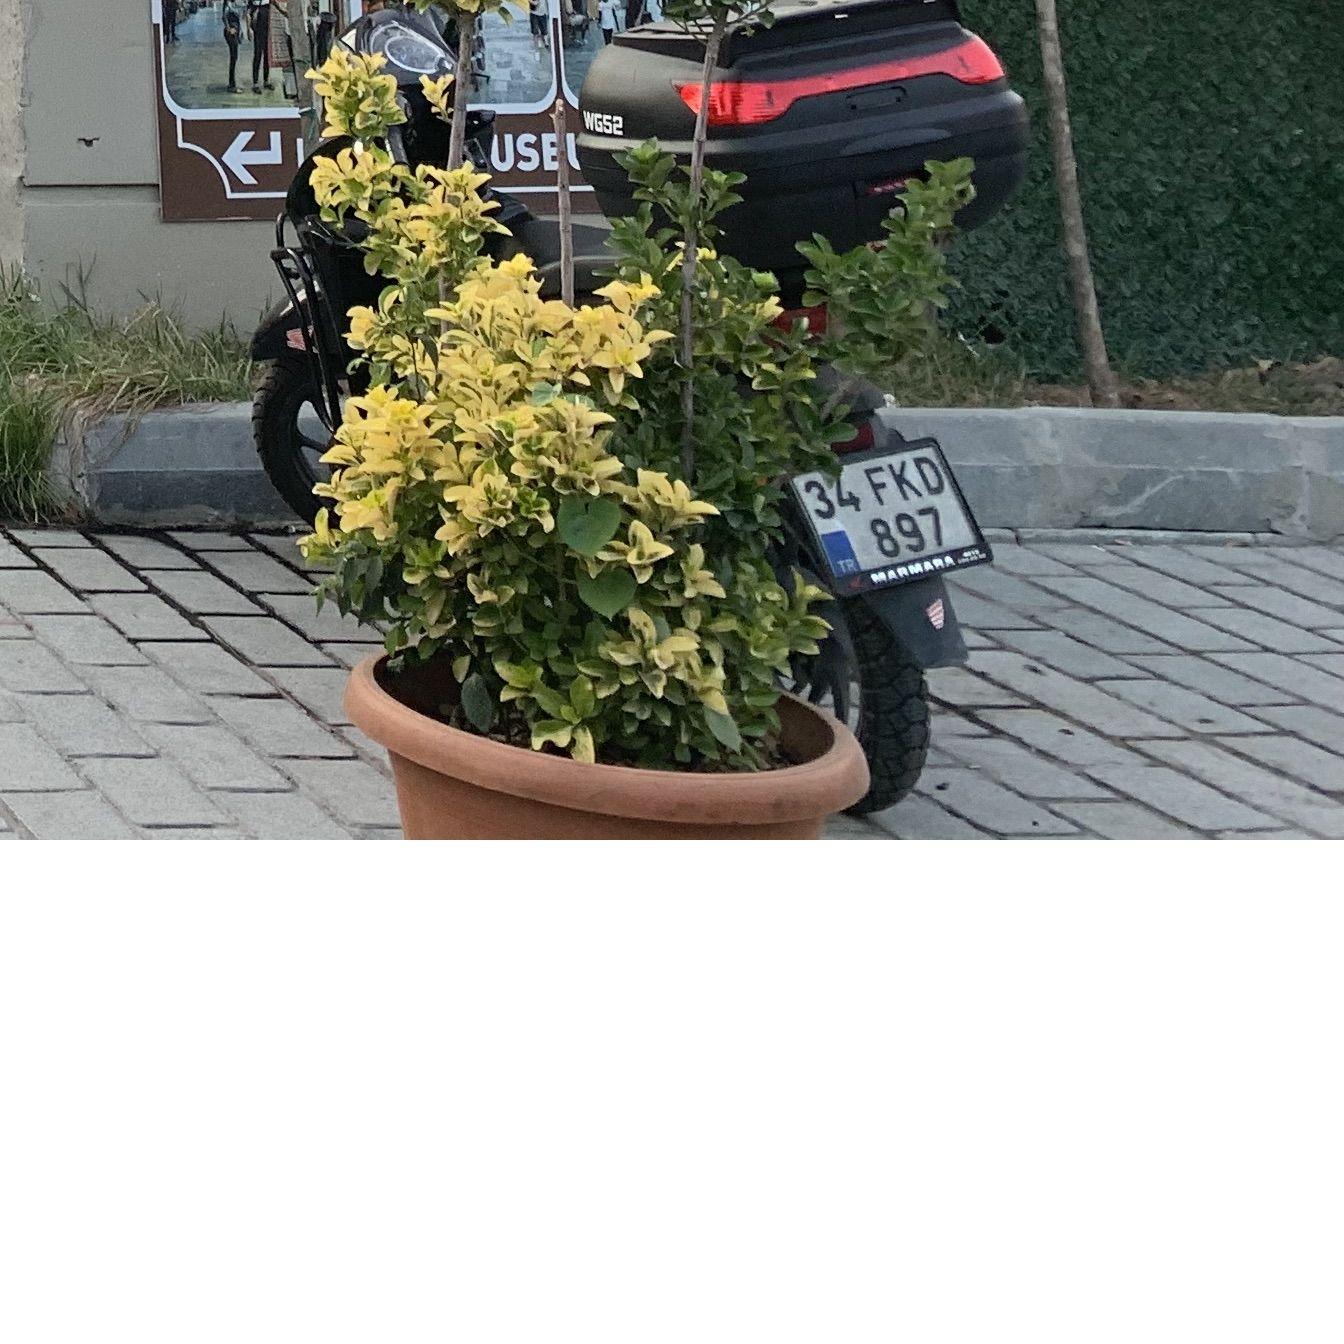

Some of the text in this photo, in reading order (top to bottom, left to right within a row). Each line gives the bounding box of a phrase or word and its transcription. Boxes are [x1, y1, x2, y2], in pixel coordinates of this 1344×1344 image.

[804, 456, 945, 520] 34 FKD
[870, 505, 944, 559] 897
[837, 559, 858, 574] TR
[870, 555, 956, 585] MARMARA
